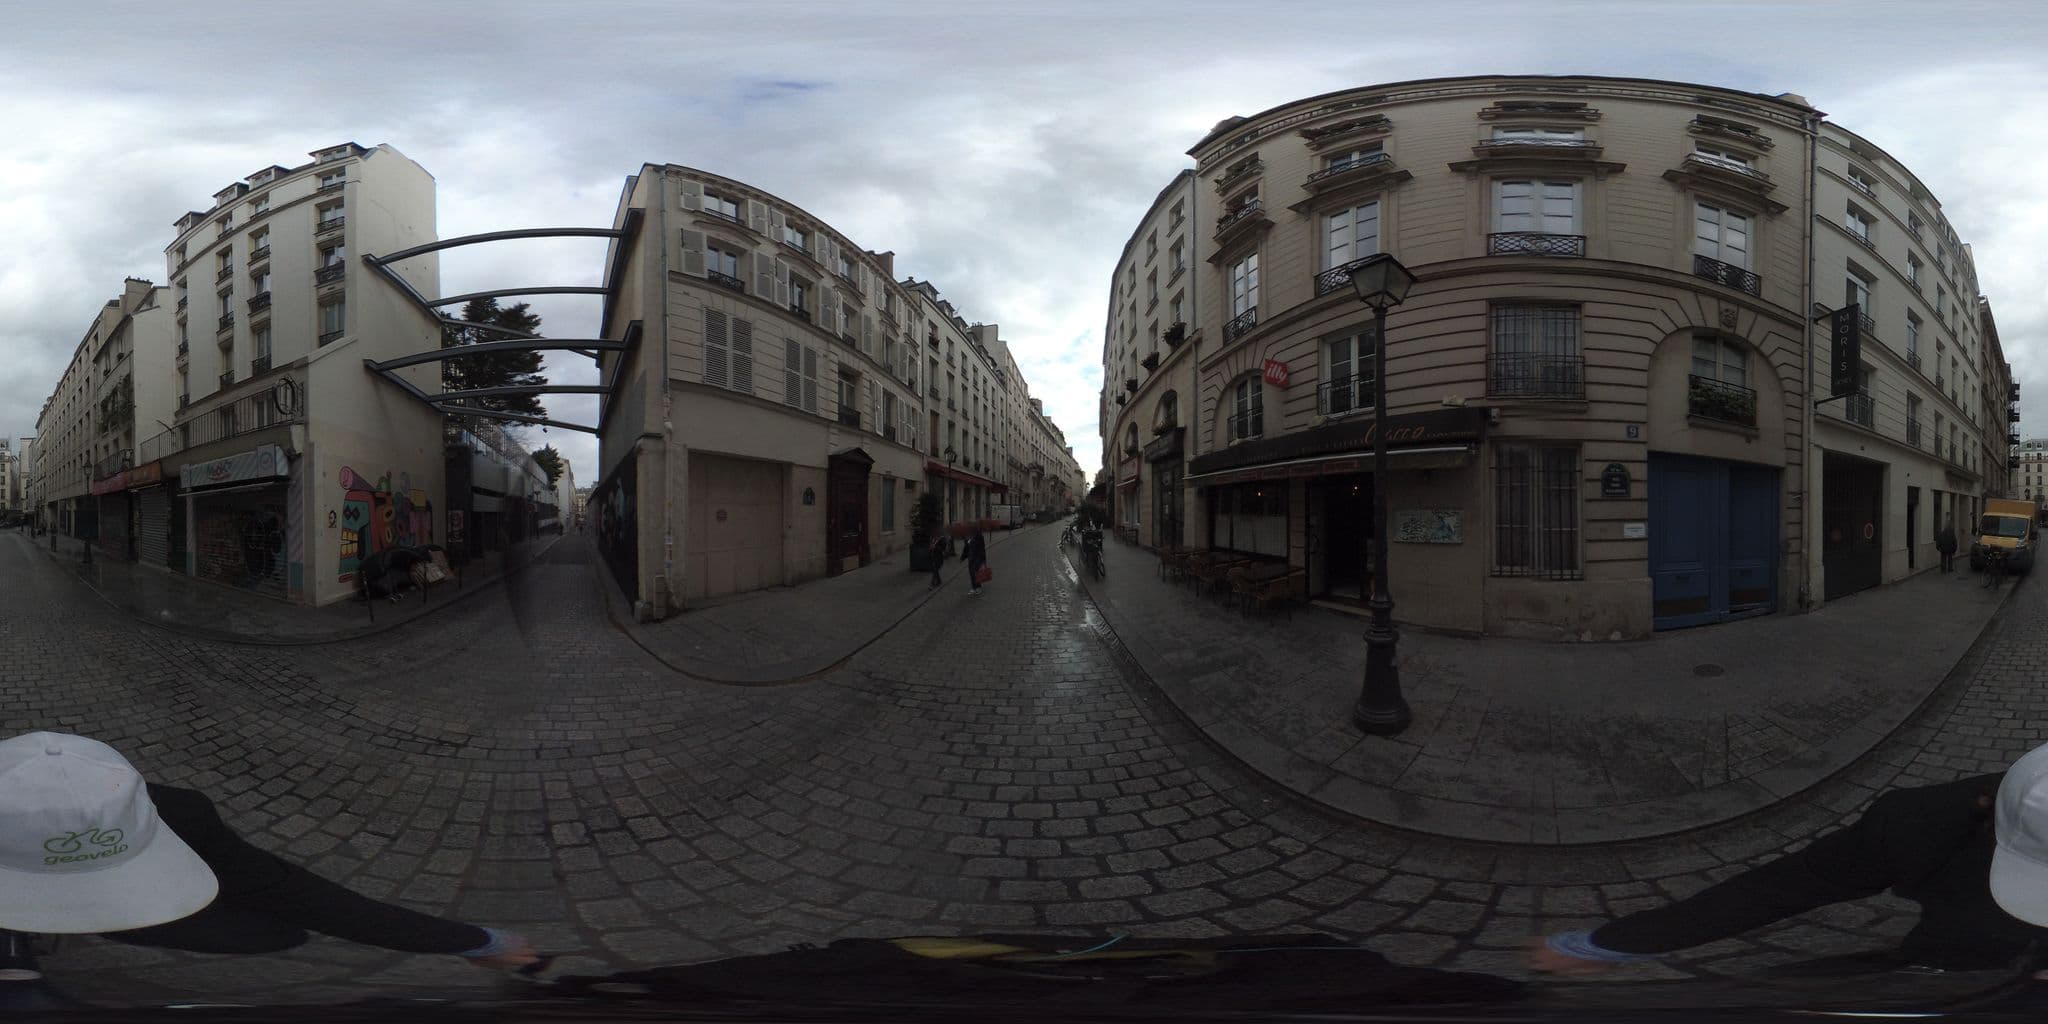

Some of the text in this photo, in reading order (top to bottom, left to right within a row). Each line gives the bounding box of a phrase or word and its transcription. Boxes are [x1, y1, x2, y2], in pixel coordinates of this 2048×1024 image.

[1839, 313, 1849, 371] MORIS
[1266, 363, 1287, 383] illy
[44, 844, 128, 865] geovelo
